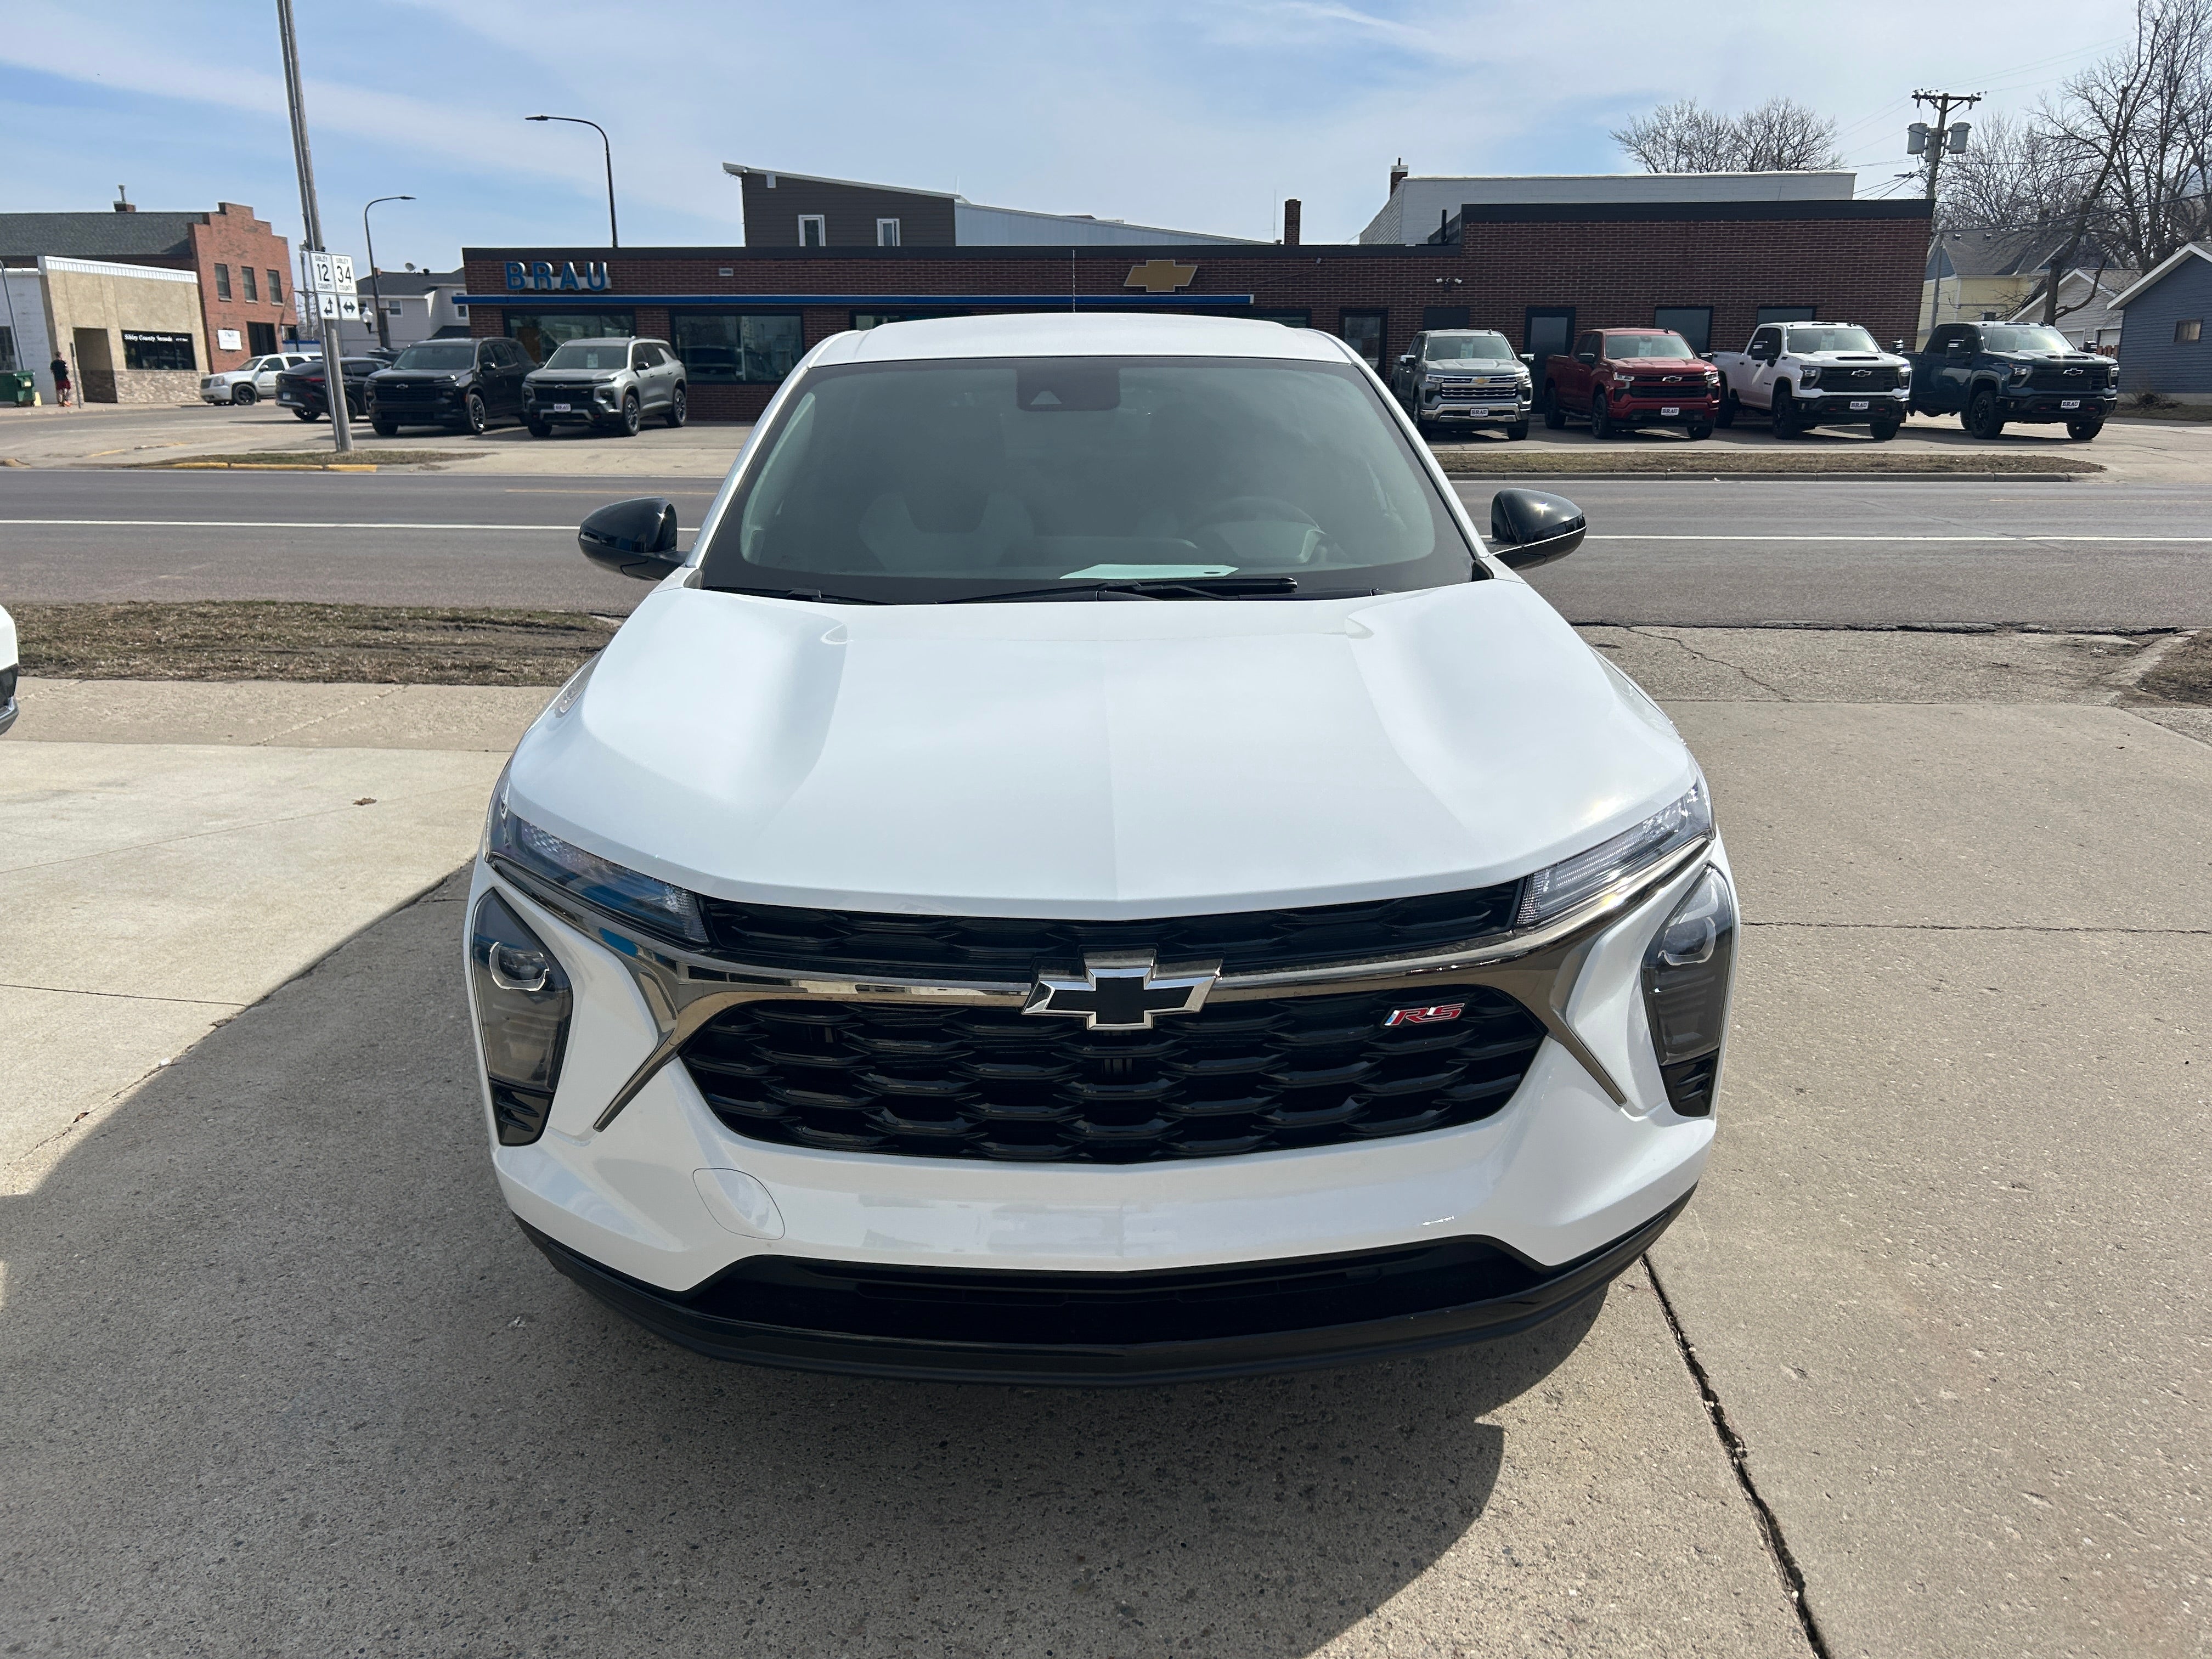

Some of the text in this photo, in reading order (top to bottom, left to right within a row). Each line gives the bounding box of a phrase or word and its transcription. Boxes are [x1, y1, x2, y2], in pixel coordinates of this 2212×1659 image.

[317, 263, 330, 282] 12
[337, 266, 352, 283] 34
[505, 261, 607, 291] BRAU
[139, 334, 156, 342] County
[1384, 1002, 1465, 1026] RS
